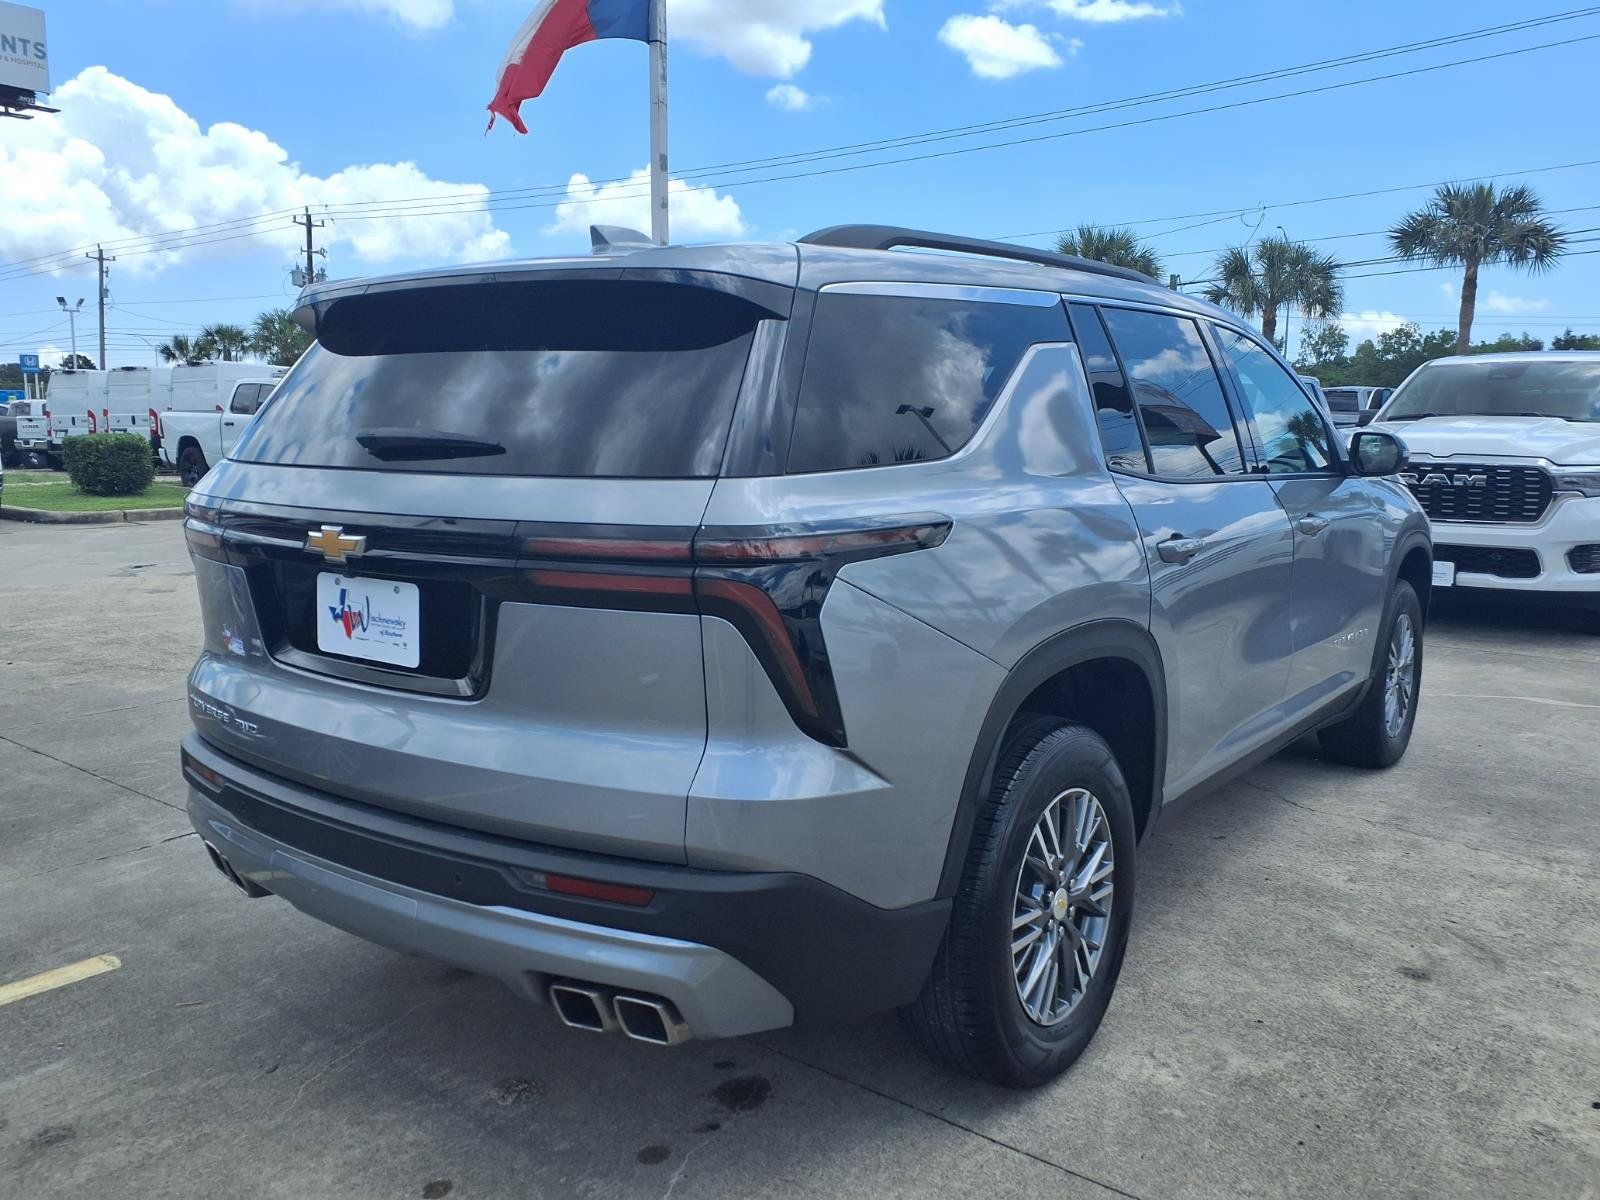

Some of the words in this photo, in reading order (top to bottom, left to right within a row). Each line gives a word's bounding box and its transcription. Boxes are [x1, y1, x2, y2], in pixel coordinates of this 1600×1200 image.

[1, 33, 47, 60] NTS
[10, 56, 47, 70] HOSPITAL
[1396, 472, 1488, 487] RAM
